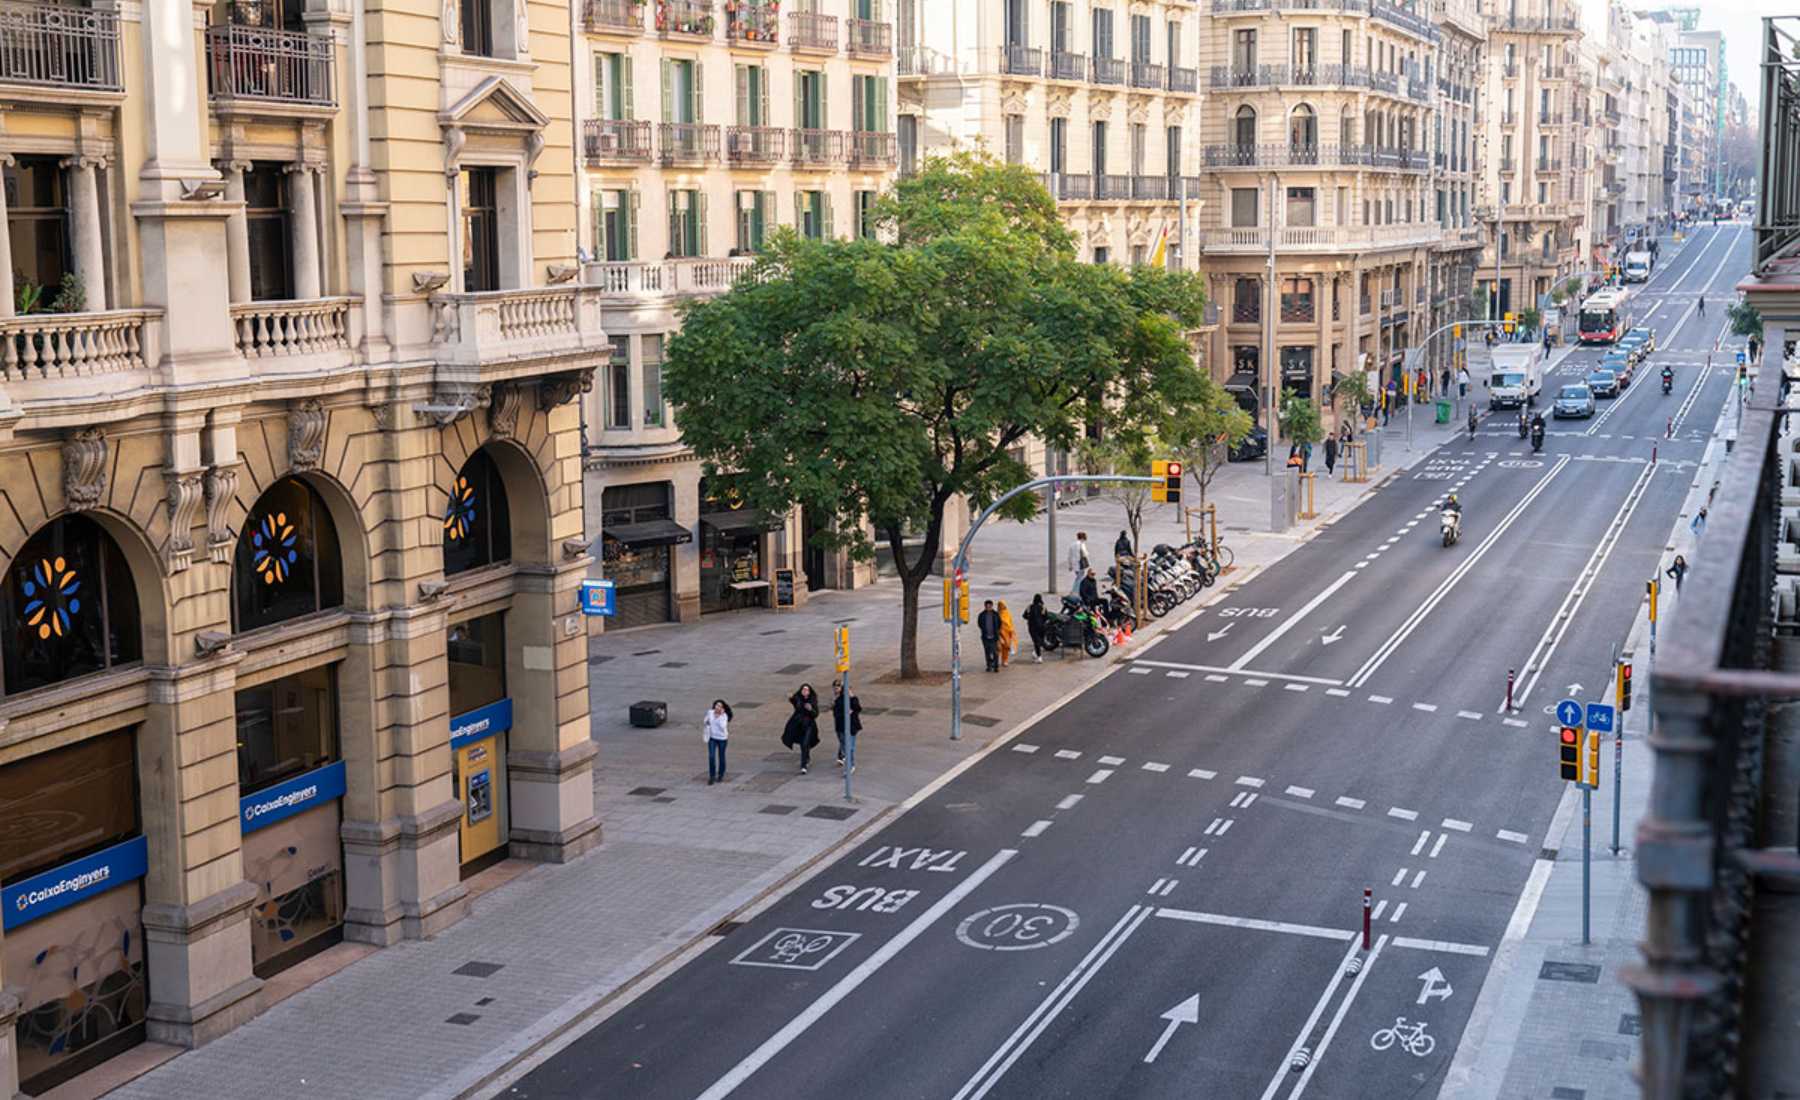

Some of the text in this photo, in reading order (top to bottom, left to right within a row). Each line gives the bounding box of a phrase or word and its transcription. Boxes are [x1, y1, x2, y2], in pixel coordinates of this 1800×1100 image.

[1218, 607, 1280, 618] BUS
[857, 846, 968, 873] TAXI
[28, 864, 110, 905] CaixaEnginyers
[811, 885, 920, 914] BUS
[984, 912, 1054, 940] 30
